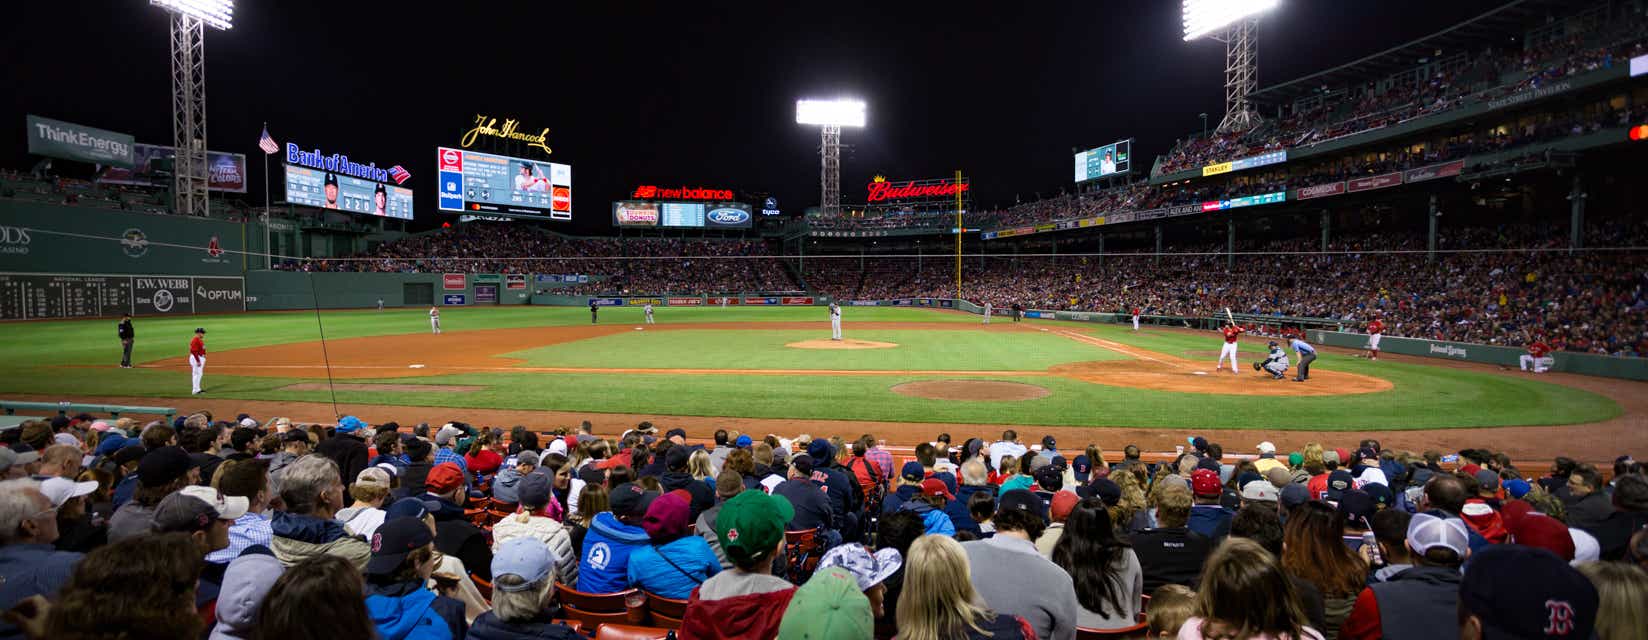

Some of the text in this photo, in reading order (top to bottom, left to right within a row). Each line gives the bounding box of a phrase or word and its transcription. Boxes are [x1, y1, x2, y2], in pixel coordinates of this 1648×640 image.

[35, 122, 129, 156] ThinkEnergy
[461, 113, 553, 155] John Hancock
[286, 142, 389, 183] Bank of America
[657, 188, 683, 199] new
[682, 186, 733, 200] balance
[867, 180, 970, 202] Budweiser
[715, 212, 742, 222] Ford
[157, 279, 189, 289] WEBB
[207, 290, 242, 300] OPTUM
[1543, 598, 1575, 636] B
